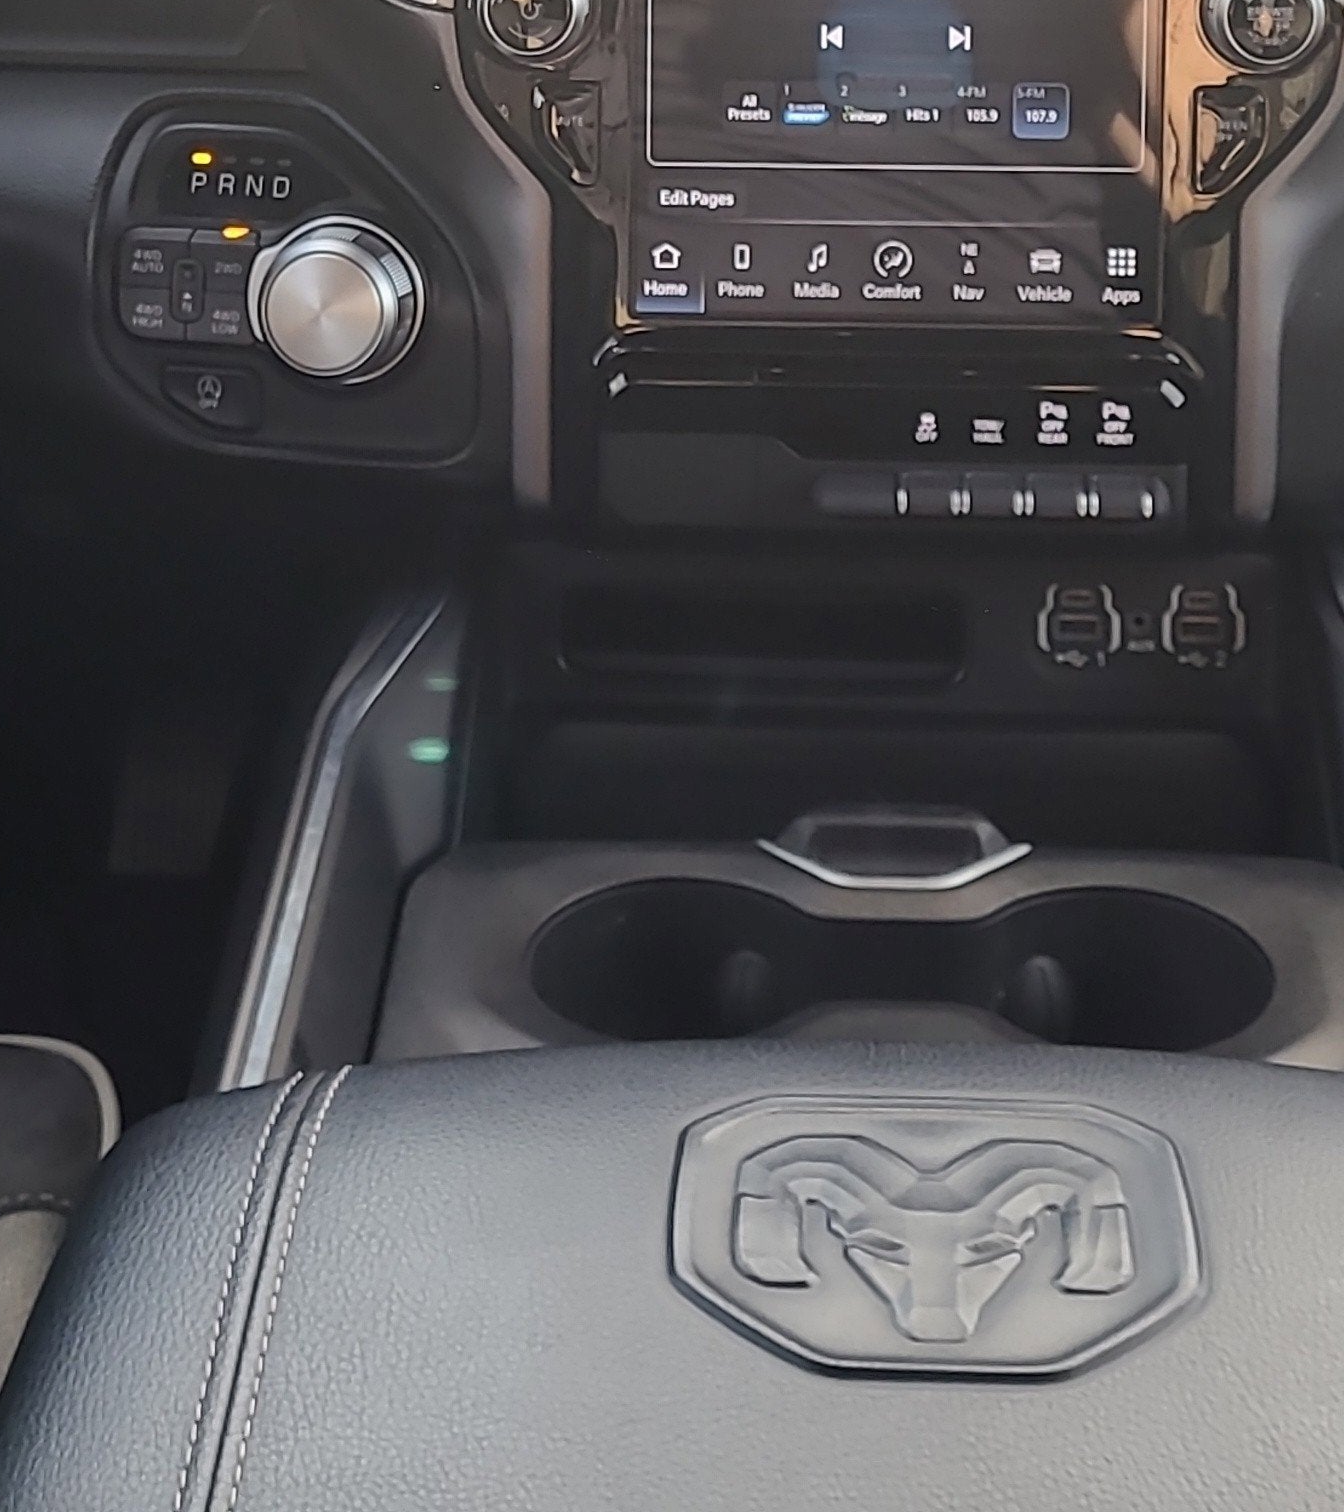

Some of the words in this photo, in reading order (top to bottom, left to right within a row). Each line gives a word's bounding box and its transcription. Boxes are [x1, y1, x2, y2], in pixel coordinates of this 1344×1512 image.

[840, 84, 849, 97] 2
[898, 84, 906, 98] 3
[727, 107, 771, 121] Presets
[1025, 109, 1058, 123] 107.9
[190, 171, 208, 194] P
[217, 172, 235, 196] R
[244, 174, 265, 199] N
[272, 176, 291, 200] D
[659, 189, 688, 206] Edit
[689, 189, 735, 209] Pages
[643, 279, 689, 297] Home
[717, 280, 765, 298] Phone
[793, 281, 840, 299] Media
[862, 282, 923, 301] Comfort
[953, 284, 986, 301] Nav
[1017, 284, 1074, 303] Vehicle
[1102, 287, 1142, 306] Apps
